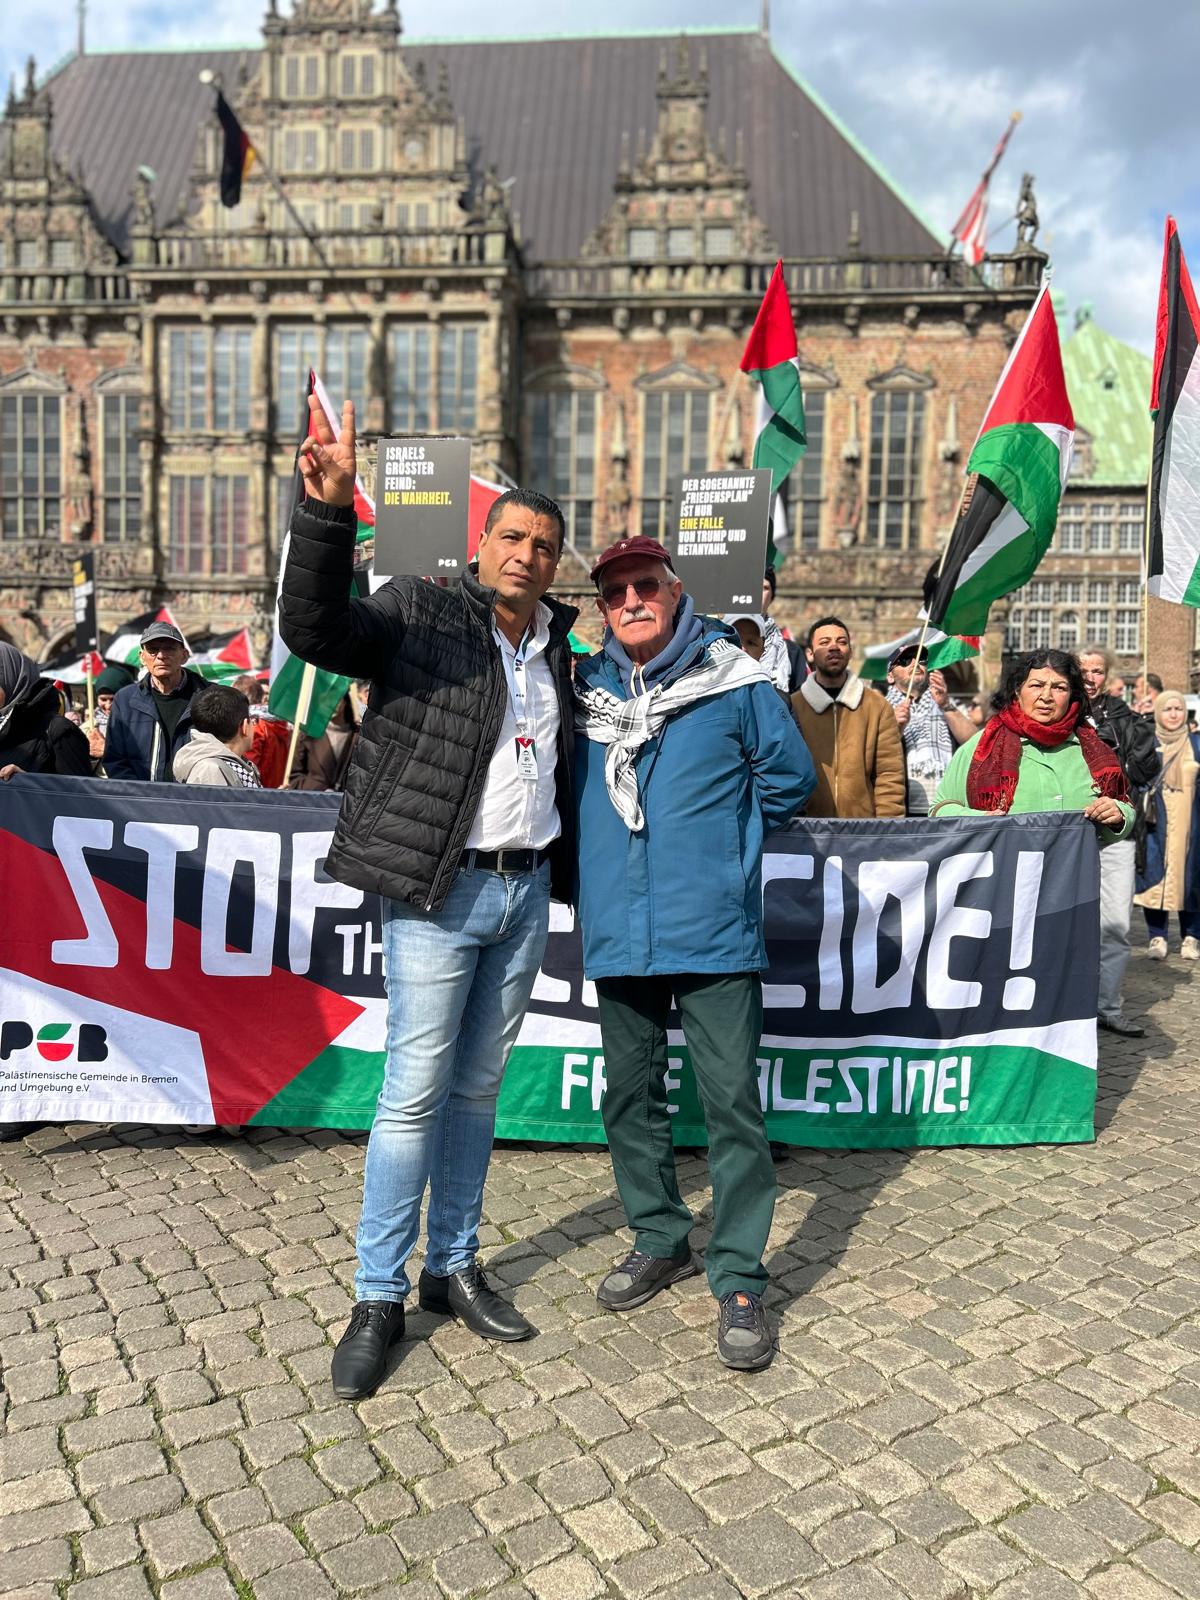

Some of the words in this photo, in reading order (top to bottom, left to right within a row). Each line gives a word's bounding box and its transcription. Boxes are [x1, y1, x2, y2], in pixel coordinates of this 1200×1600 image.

[385, 447, 425, 460] ISRAELS
[385, 460, 434, 475] GRÖSSTER
[385, 476, 416, 490] FEIND:
[682, 479, 699, 491] DER
[700, 476, 755, 490] SOGENANNTE
[384, 492, 400, 505] DIE
[401, 492, 452, 505] WAHRHEIT.
[680, 504, 694, 517] IST
[694, 504, 713, 517] NUR
[680, 518, 698, 530] EINE
[699, 517, 724, 529] FALLE
[679, 531, 696, 543] VON
[697, 530, 727, 542] TRUMP
[728, 529, 747, 541] UND
[677, 543, 729, 556] NETANYAHU.
[438, 558, 458, 568] PGB
[732, 595, 753, 604] PGB
[51, 816, 364, 976] STOP
[335, 921, 387, 977] TH
[0, 1070, 78, 1080] Palästinensische
[80, 1072, 128, 1082] Gemeinde
[130, 1074, 139, 1083] in
[141, 1075, 178, 1084] Bremen
[20, 1083, 73, 1094] Umgebung
